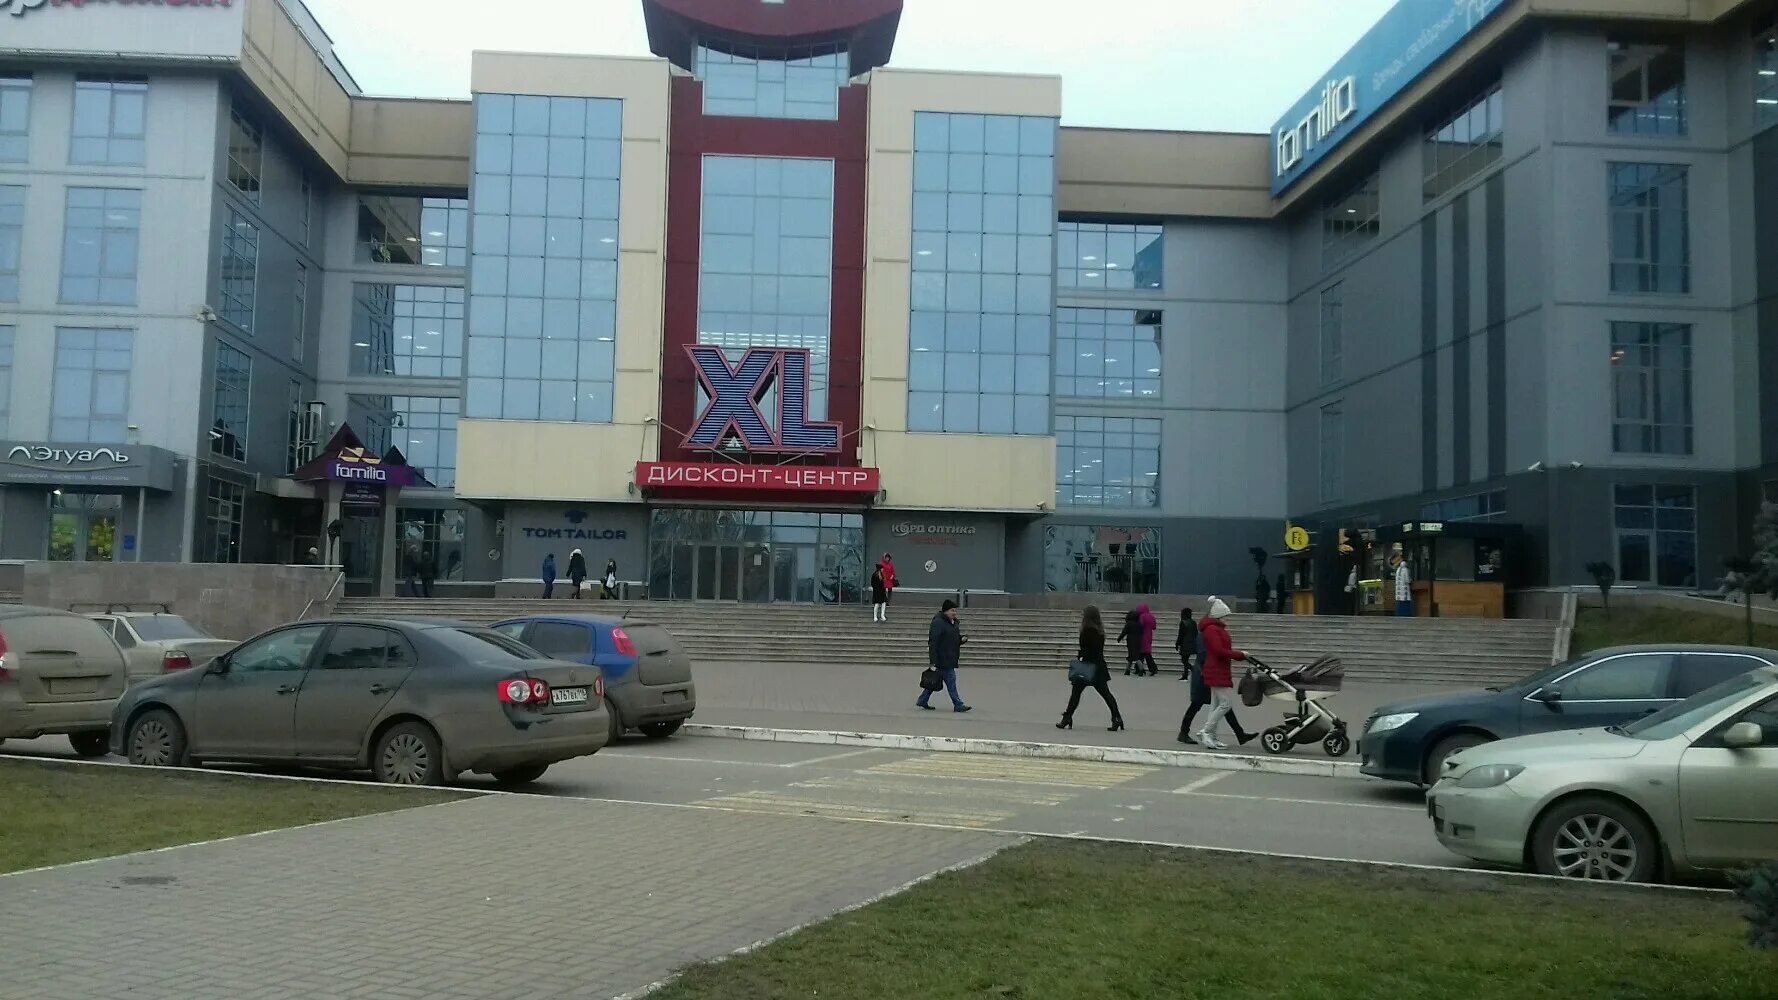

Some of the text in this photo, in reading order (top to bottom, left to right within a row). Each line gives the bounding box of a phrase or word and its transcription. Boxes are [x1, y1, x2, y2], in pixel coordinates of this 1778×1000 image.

[1277, 75, 1358, 177] familia
[679, 344, 843, 452] XL
[336, 463, 386, 480] familia
[648, 465, 868, 488] ДИСКОНТ-ЦЕНТР
[522, 527, 627, 540] TOM TAILOR
